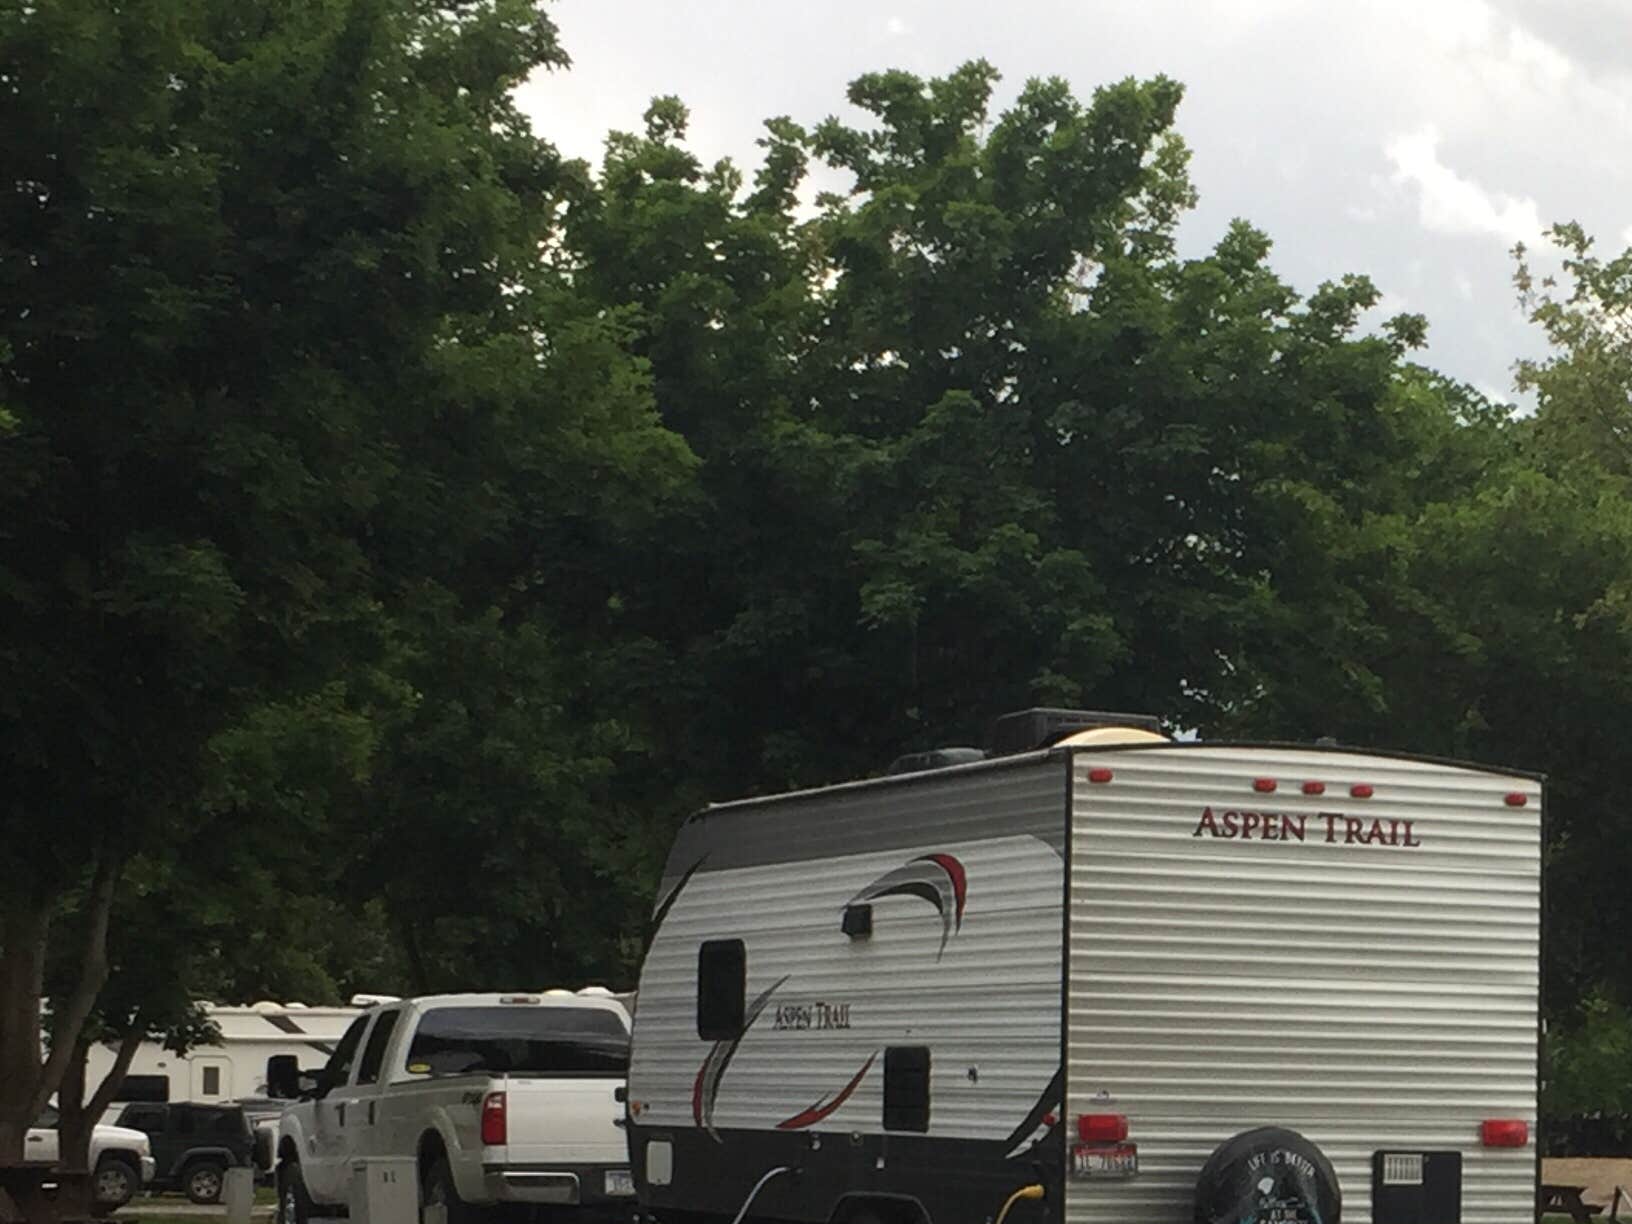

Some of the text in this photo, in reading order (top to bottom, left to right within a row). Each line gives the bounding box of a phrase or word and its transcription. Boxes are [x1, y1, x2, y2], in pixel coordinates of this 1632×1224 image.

[1193, 807, 1421, 847] ASPEN TRAIL
[773, 1002, 851, 1031] ASPEN TRAIL
